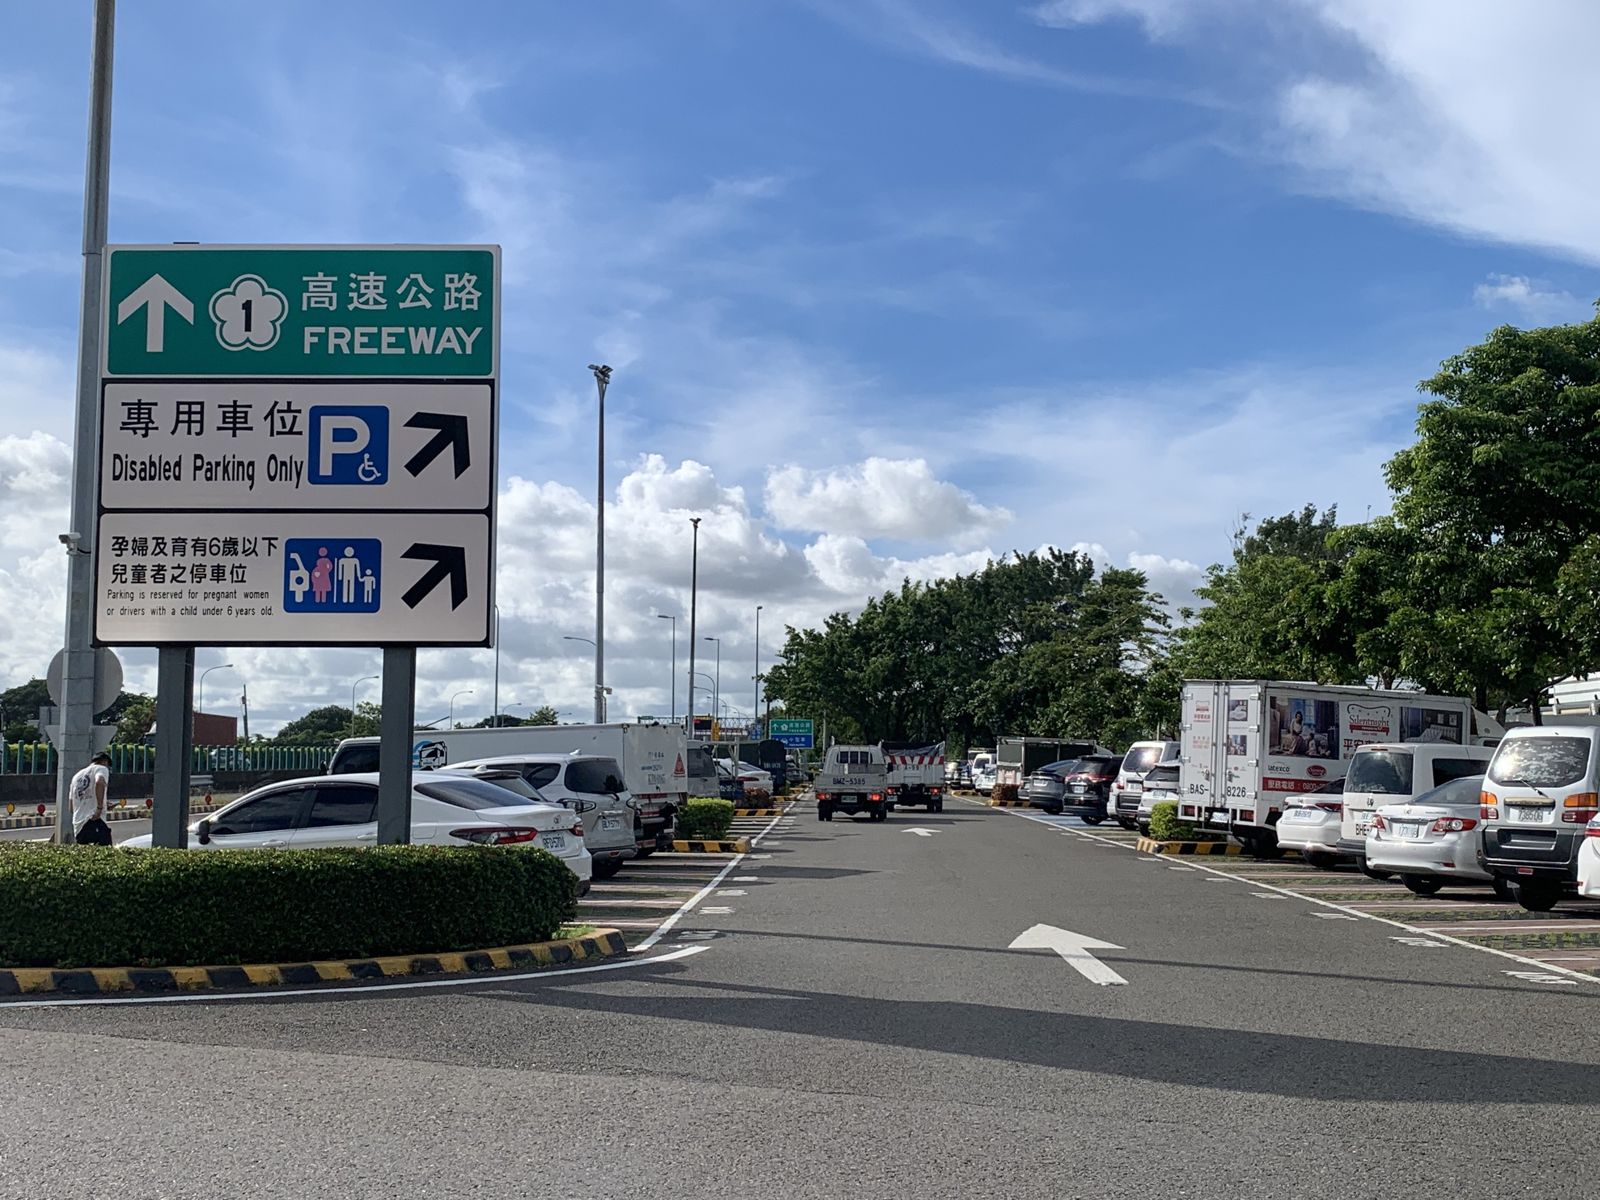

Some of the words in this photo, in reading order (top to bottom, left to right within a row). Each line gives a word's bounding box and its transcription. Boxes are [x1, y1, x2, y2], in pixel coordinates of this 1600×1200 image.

[301, 271, 483, 311] 高速公路
[240, 299, 253, 333] 1
[303, 326, 484, 355] FREEWAY
[119, 398, 305, 439] 專用車位
[318, 414, 371, 477] P
[111, 453, 182, 482] Disabled
[192, 453, 256, 491] Parking
[266, 454, 305, 489] Only
[111, 535, 279, 557] 孕婦及育有6歲以下
[111, 563, 247, 584] 兒童者之停車位
[106, 588, 135, 602] Parking
[138, 589, 146, 600] is
[149, 589, 184, 600] reserved
[187, 588, 199, 600] for
[203, 588, 238, 602] pregnant
[243, 590, 270, 600] women
[106, 607, 115, 616] or
[119, 605, 146, 616] drivers
[150, 605, 167, 616] with
[171, 607, 176, 616] a
[180, 605, 198, 616] child
[202, 605, 223, 616] under
[226, 605, 233, 616] 6
[235, 607, 256, 618] years
[260, 605, 274, 616] old.
[1226, 786, 1247, 798] 8226
